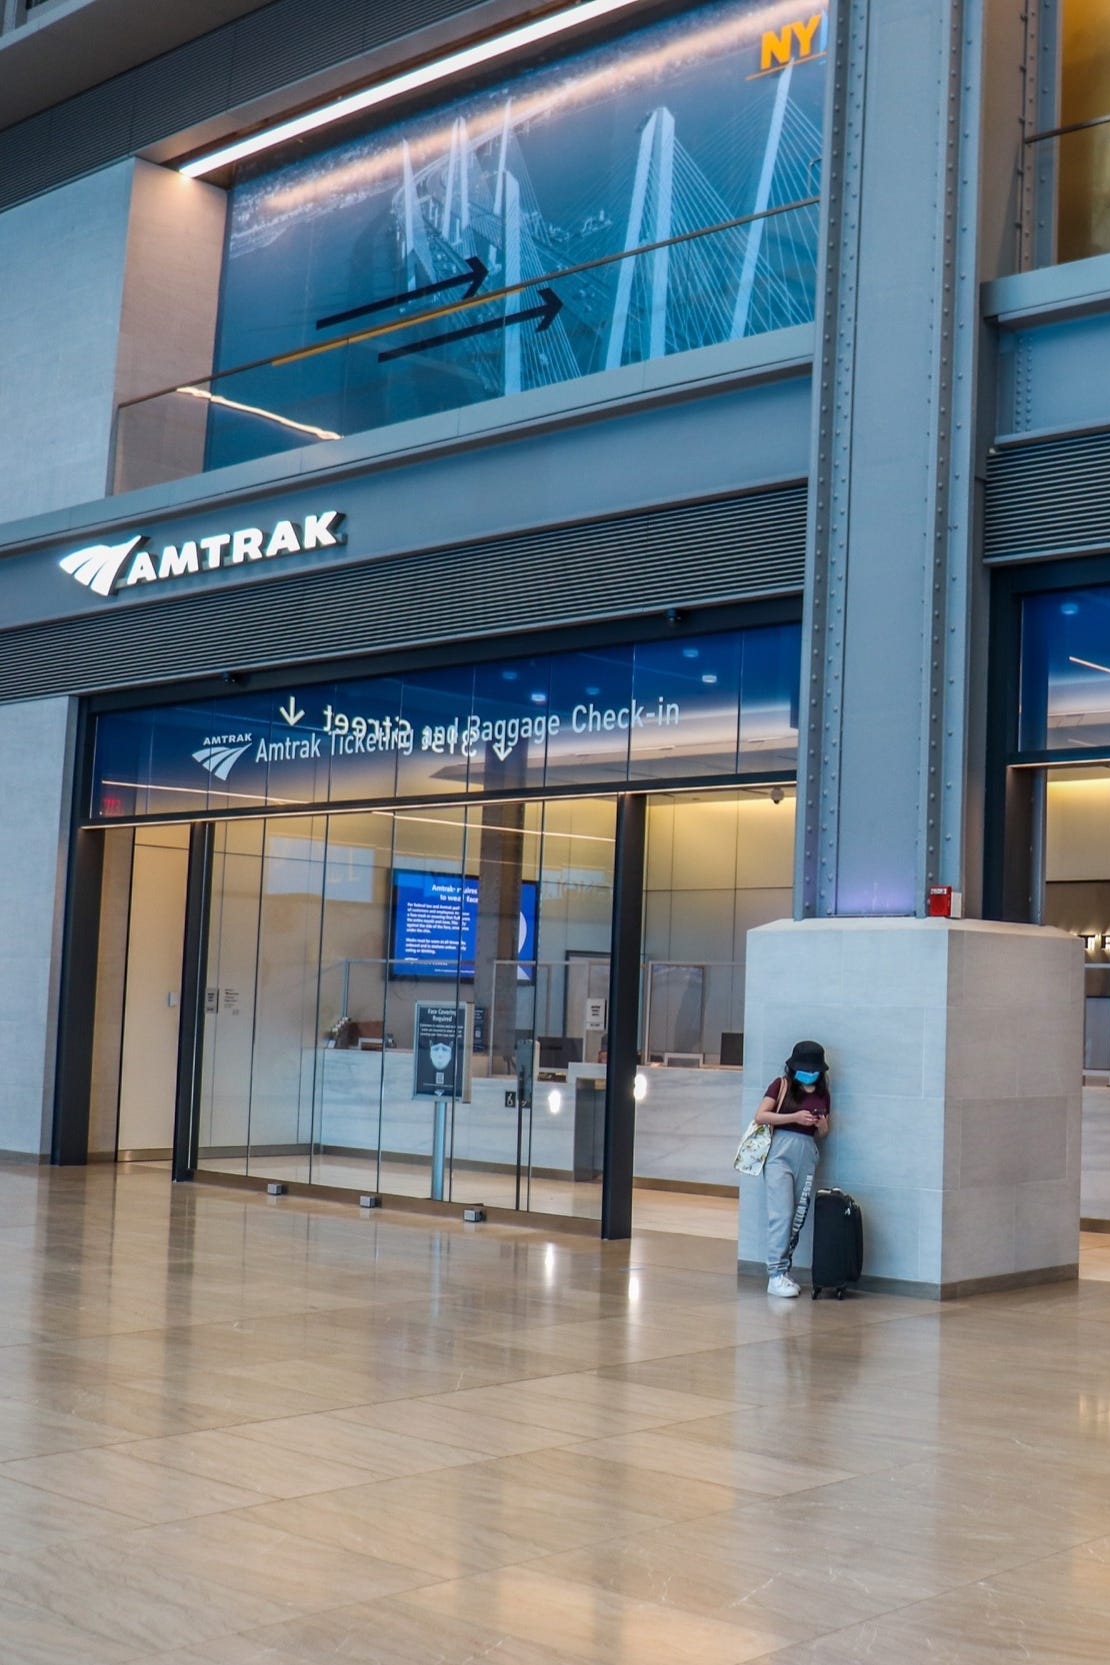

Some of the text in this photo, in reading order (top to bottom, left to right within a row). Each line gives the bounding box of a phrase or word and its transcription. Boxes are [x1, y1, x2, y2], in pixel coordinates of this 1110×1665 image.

[126, 510, 347, 586] AMTRAK
[202, 733, 252, 746] AMTRAK
[255, 696, 681, 763] Amtrak Ticketing and Baggage Check-in
